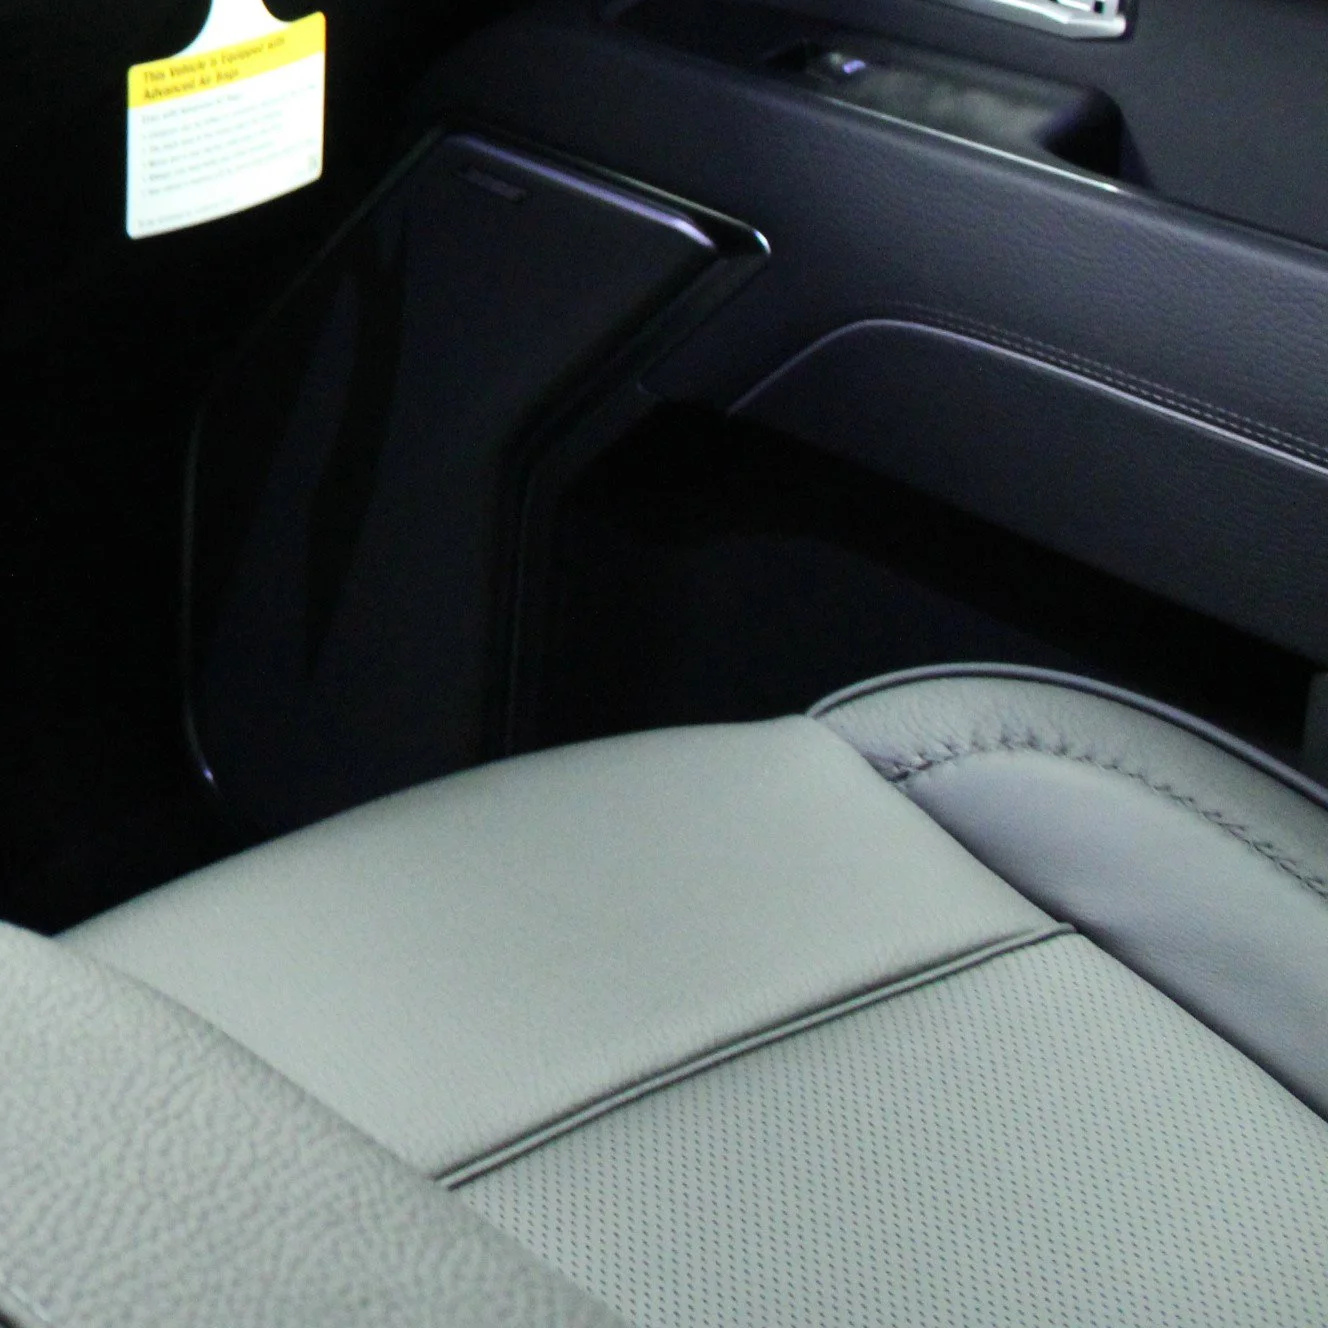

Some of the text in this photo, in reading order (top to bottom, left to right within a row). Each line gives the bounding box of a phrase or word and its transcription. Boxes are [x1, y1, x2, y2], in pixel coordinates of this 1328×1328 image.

[143, 70, 167, 84] This
[169, 59, 207, 78] Vehicle
[143, 80, 196, 101] Advanced
